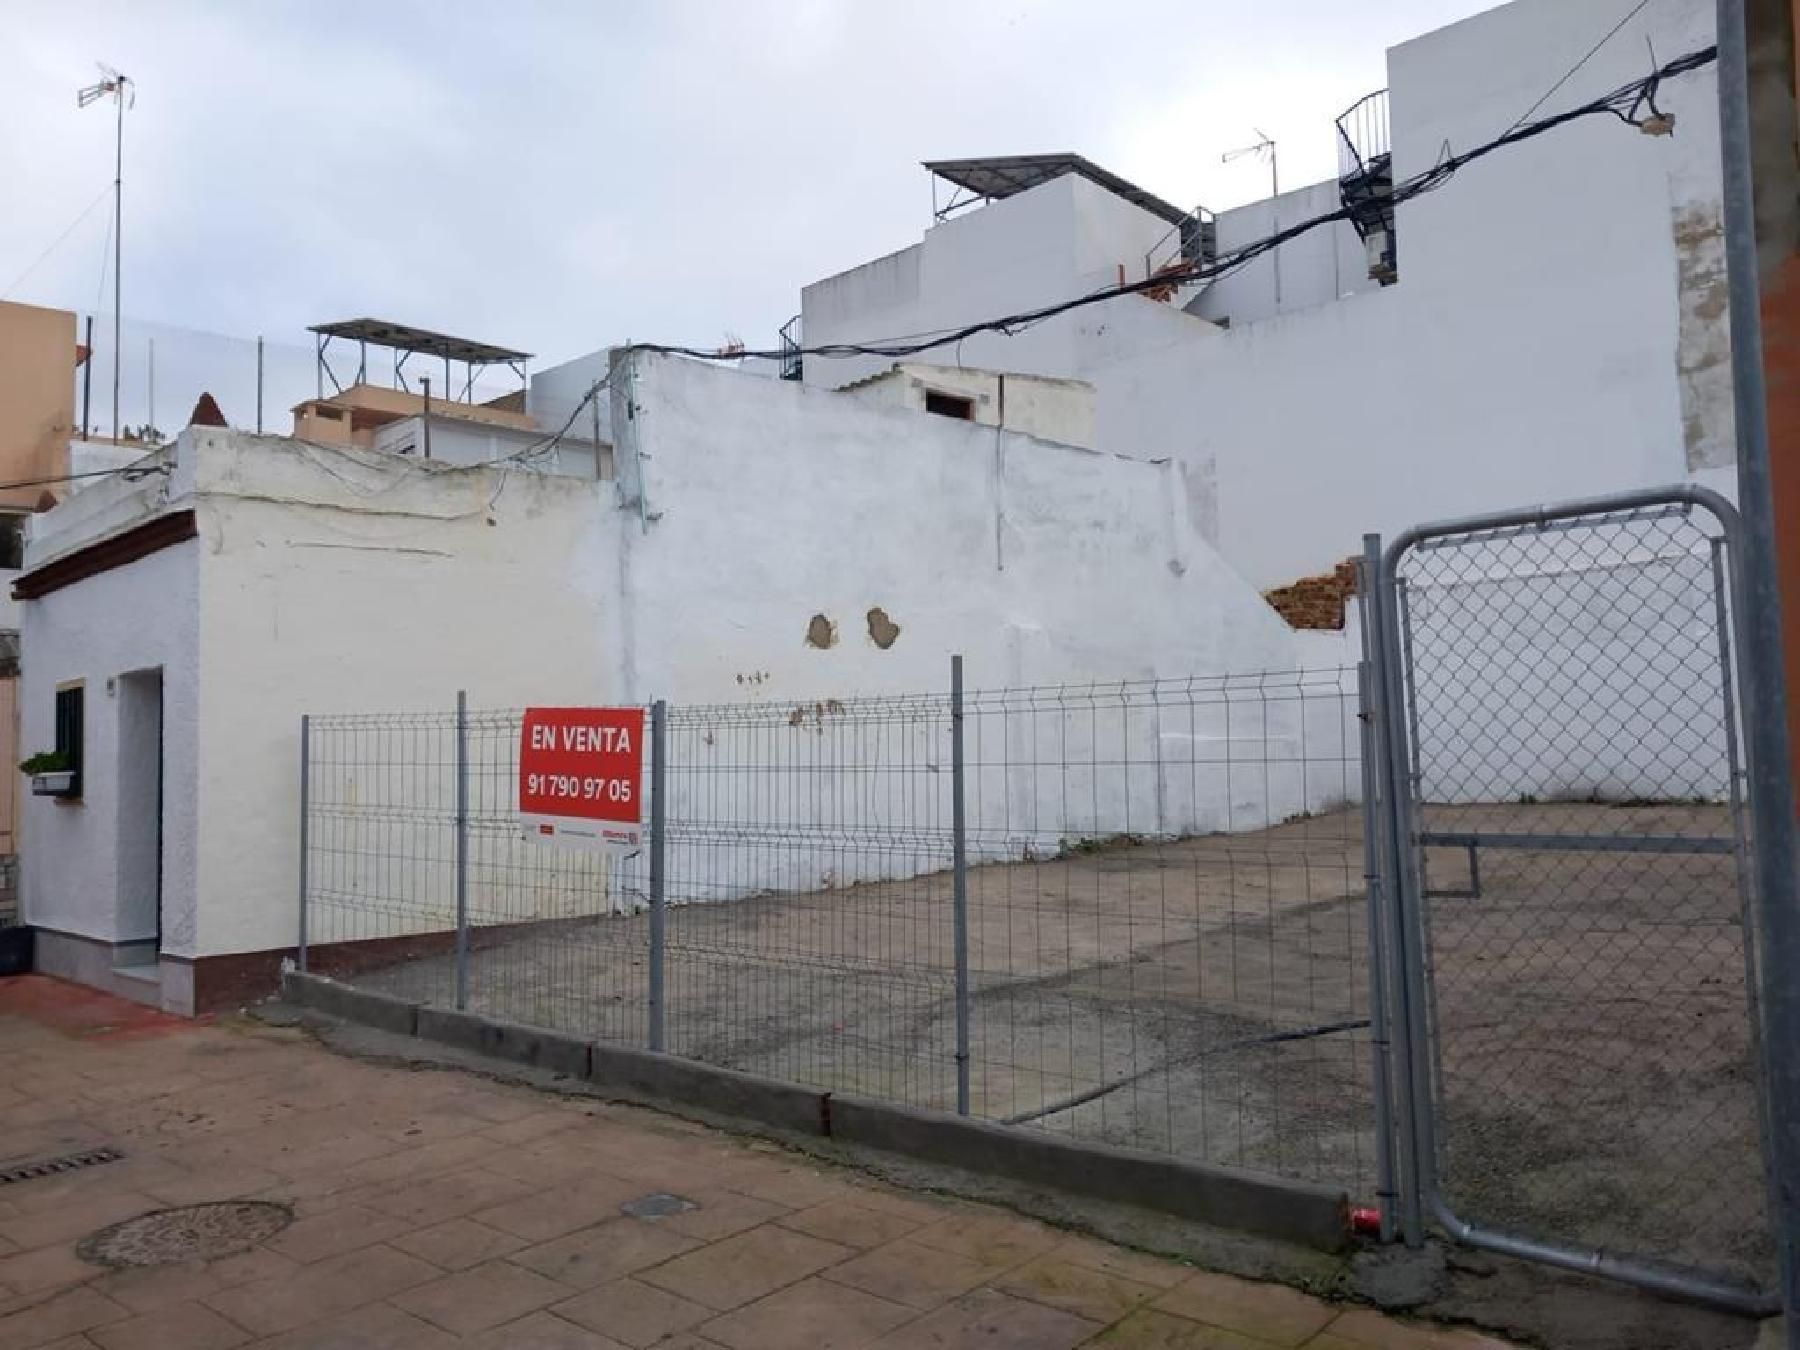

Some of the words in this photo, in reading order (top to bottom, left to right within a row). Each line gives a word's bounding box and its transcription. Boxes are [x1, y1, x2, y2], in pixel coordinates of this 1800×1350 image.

[532, 725, 556, 750] EN
[563, 726, 631, 753] VENTA
[584, 777, 606, 800] 97
[609, 779, 632, 803] 05
